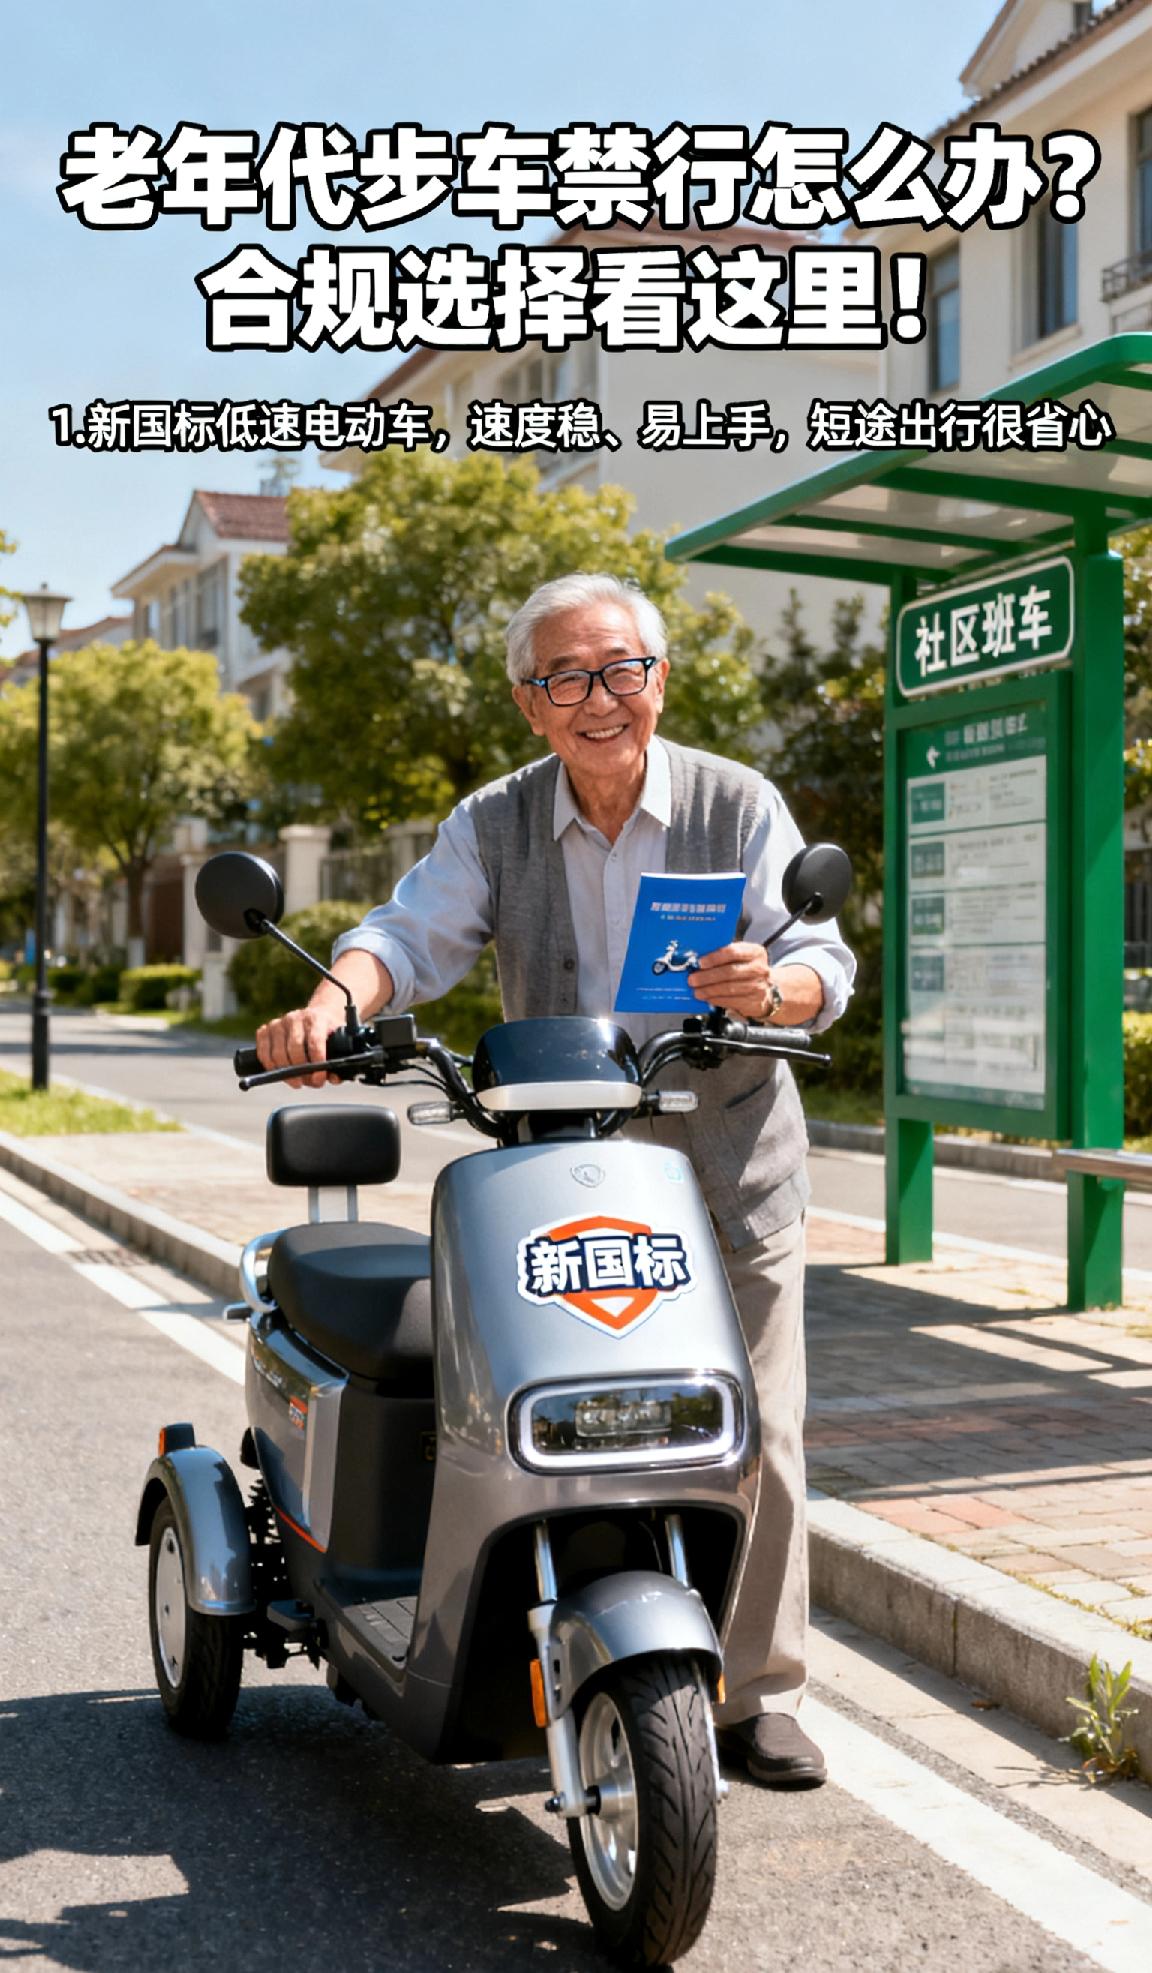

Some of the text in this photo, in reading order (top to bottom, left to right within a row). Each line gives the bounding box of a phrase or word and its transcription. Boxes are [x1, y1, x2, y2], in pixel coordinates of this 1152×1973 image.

[915, 584, 1052, 677] 社区班车
[528, 1235, 687, 1294] 新国标
